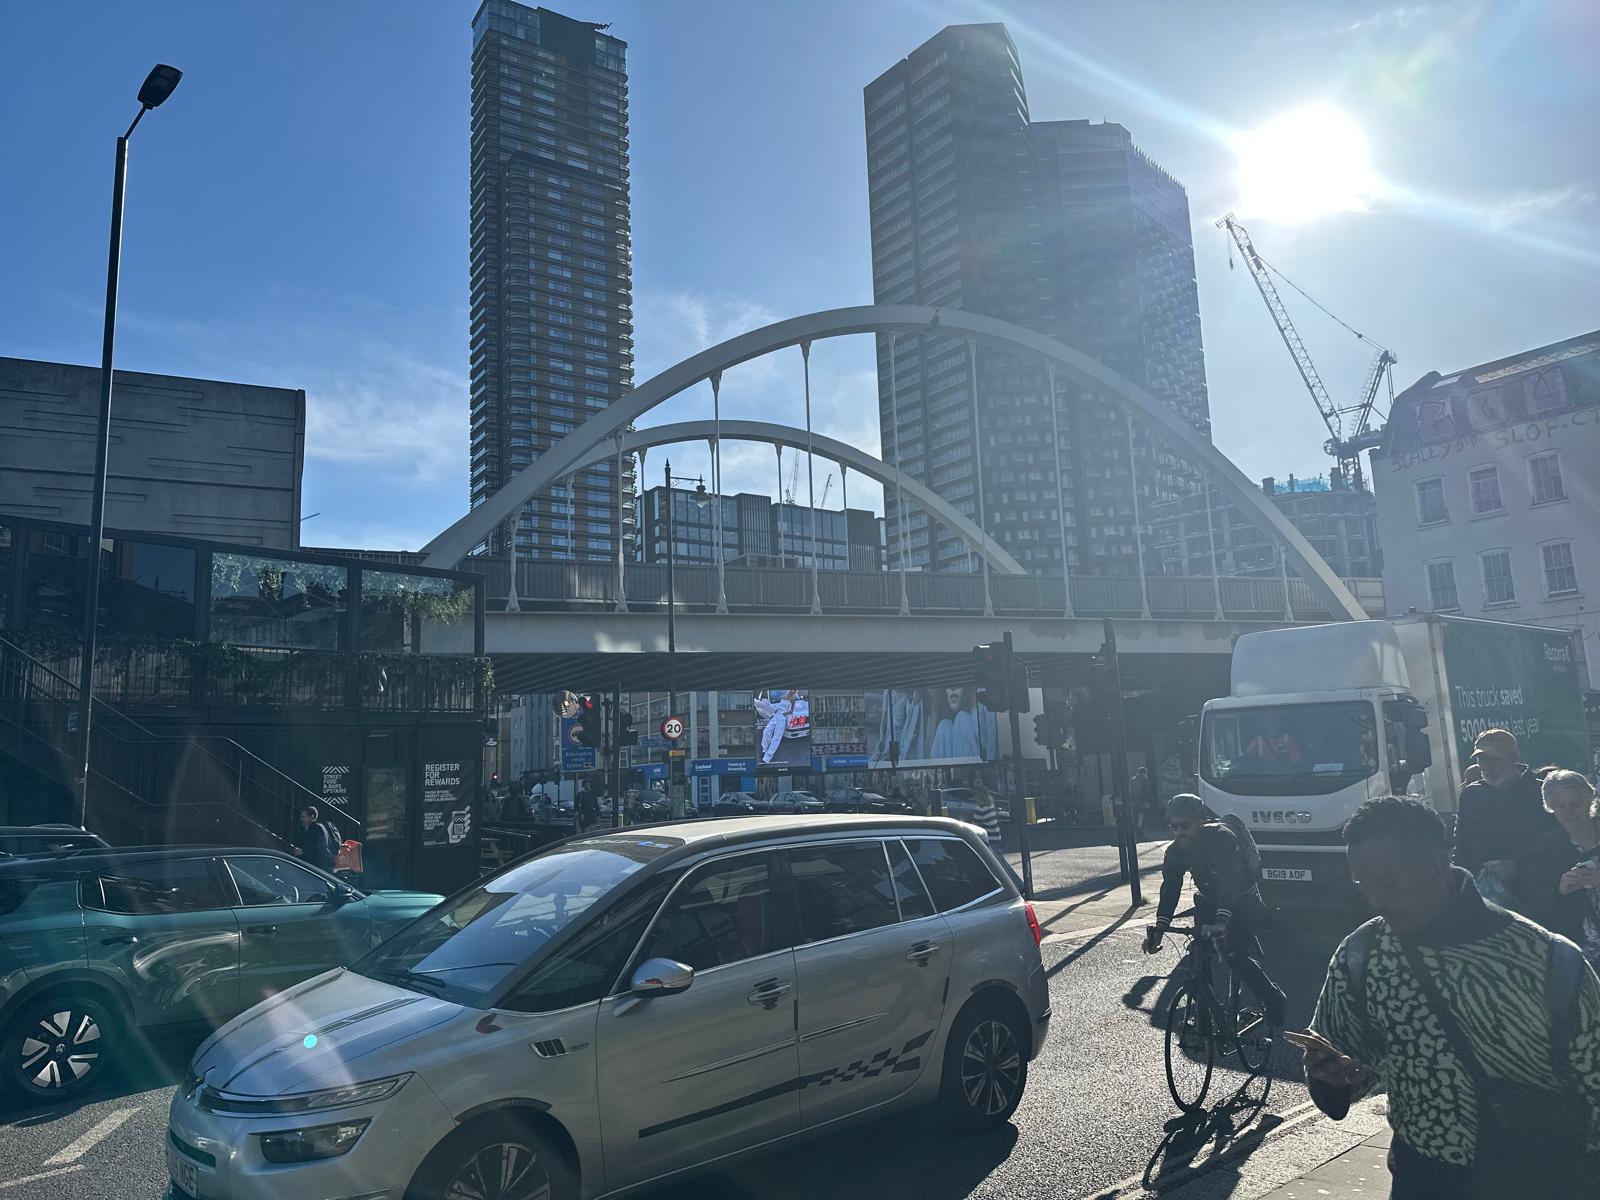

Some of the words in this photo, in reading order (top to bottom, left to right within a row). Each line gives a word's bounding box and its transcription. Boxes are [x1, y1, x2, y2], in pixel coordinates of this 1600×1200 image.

[1455, 684, 1476, 709] This
[1476, 685, 1499, 707] truck
[1500, 683, 1524, 705] saved
[666, 723, 681, 733] 20
[1460, 717, 1487, 743] 5000
[1510, 714, 1526, 736] last
[1526, 716, 1541, 737] year
[425, 763, 460, 771] REGISTER
[425, 771, 440, 779] FOR
[425, 778, 460, 786] REWARDS
[1252, 810, 1312, 824] IVECO
[1267, 869, 1287, 879] BG19
